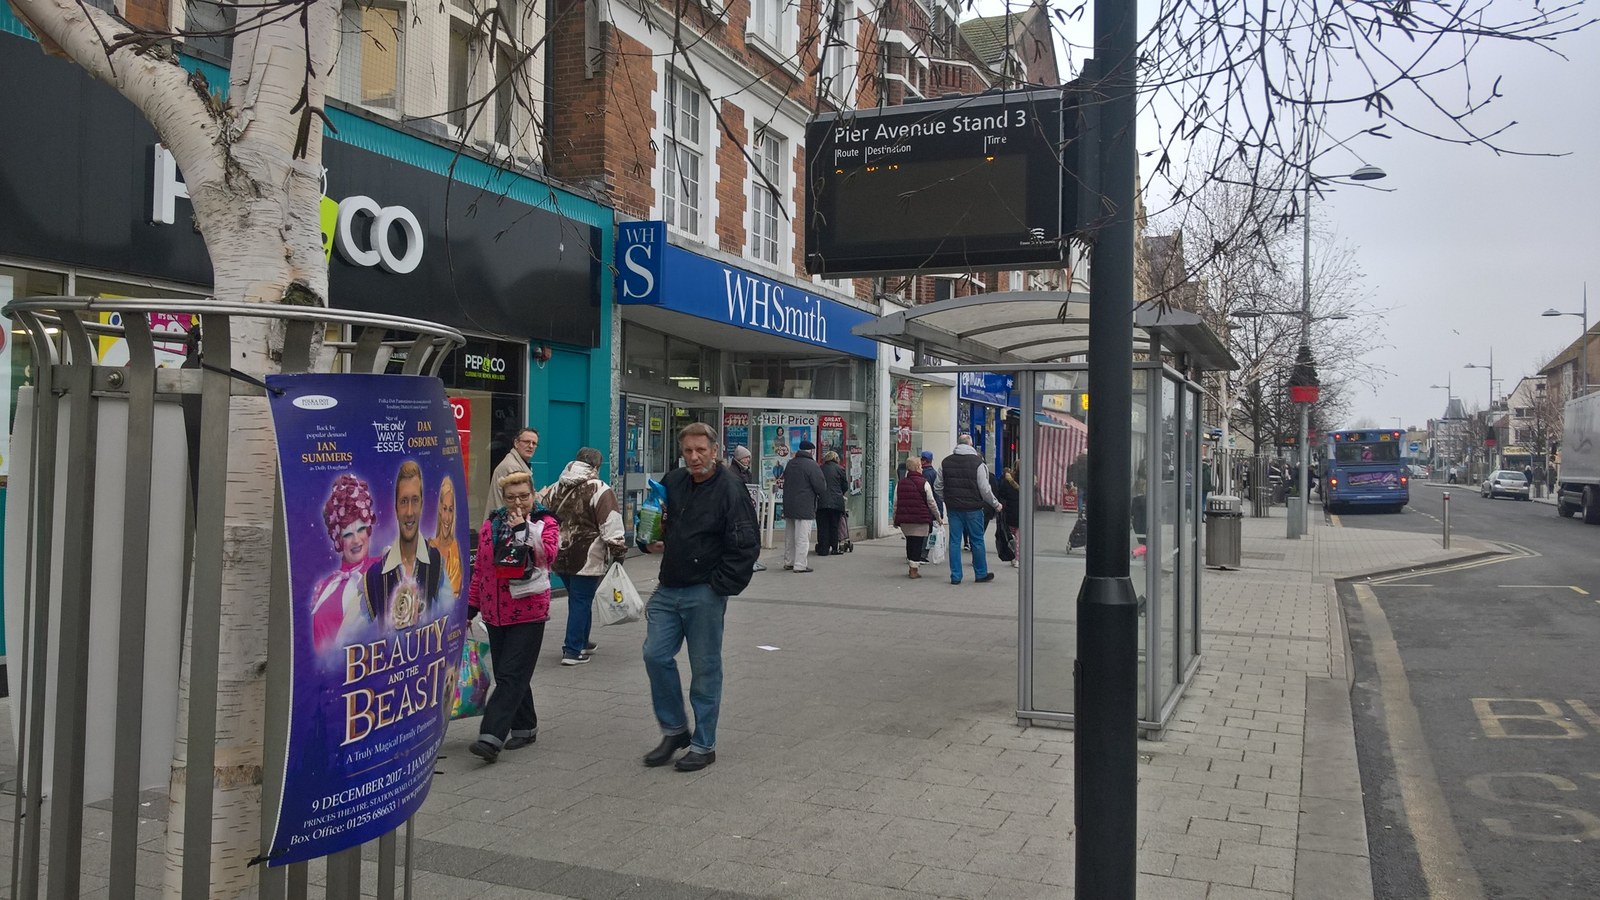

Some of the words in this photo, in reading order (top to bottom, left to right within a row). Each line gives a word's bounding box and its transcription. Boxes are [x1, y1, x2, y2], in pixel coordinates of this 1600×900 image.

[835, 126, 868, 143] Pier
[874, 119, 946, 140] Avenue
[952, 110, 1008, 133] Stand
[1015, 110, 1026, 128] 3
[987, 135, 1007, 145] Time
[837, 149, 859, 158] Route
[626, 228, 654, 243] WH
[623, 244, 655, 298] S
[723, 268, 828, 344] WHSmith
[390, 421, 406, 431] ONLY
[417, 421, 432, 431] DAN
[788, 415, 815, 426] Price
[379, 432, 396, 441] WAY
[397, 432, 405, 441] IS
[408, 436, 438, 448] OSBORNE
[317, 442, 337, 451] IAN
[374, 442, 406, 454] ESSEX
[302, 452, 353, 463] SUMMERS
[342, 614, 449, 686] BEAUTY
[388, 672, 404, 685] AND
[406, 666, 419, 679] THE
[340, 656, 445, 747] BEAST
[346, 754, 353, 765] A
[354, 747, 373, 760] Truly
[374, 735, 399, 753] Magical
[312, 800, 319, 813] 9
[322, 778, 384, 810] DECEMBER
[385, 768, 403, 787] 2017
[290, 834, 310, 845] Box
[312, 823, 345, 840] Office:
[346, 811, 371, 830] 01255
[372, 800, 396, 820] 686633
[303, 813, 336, 828] PRINCES
